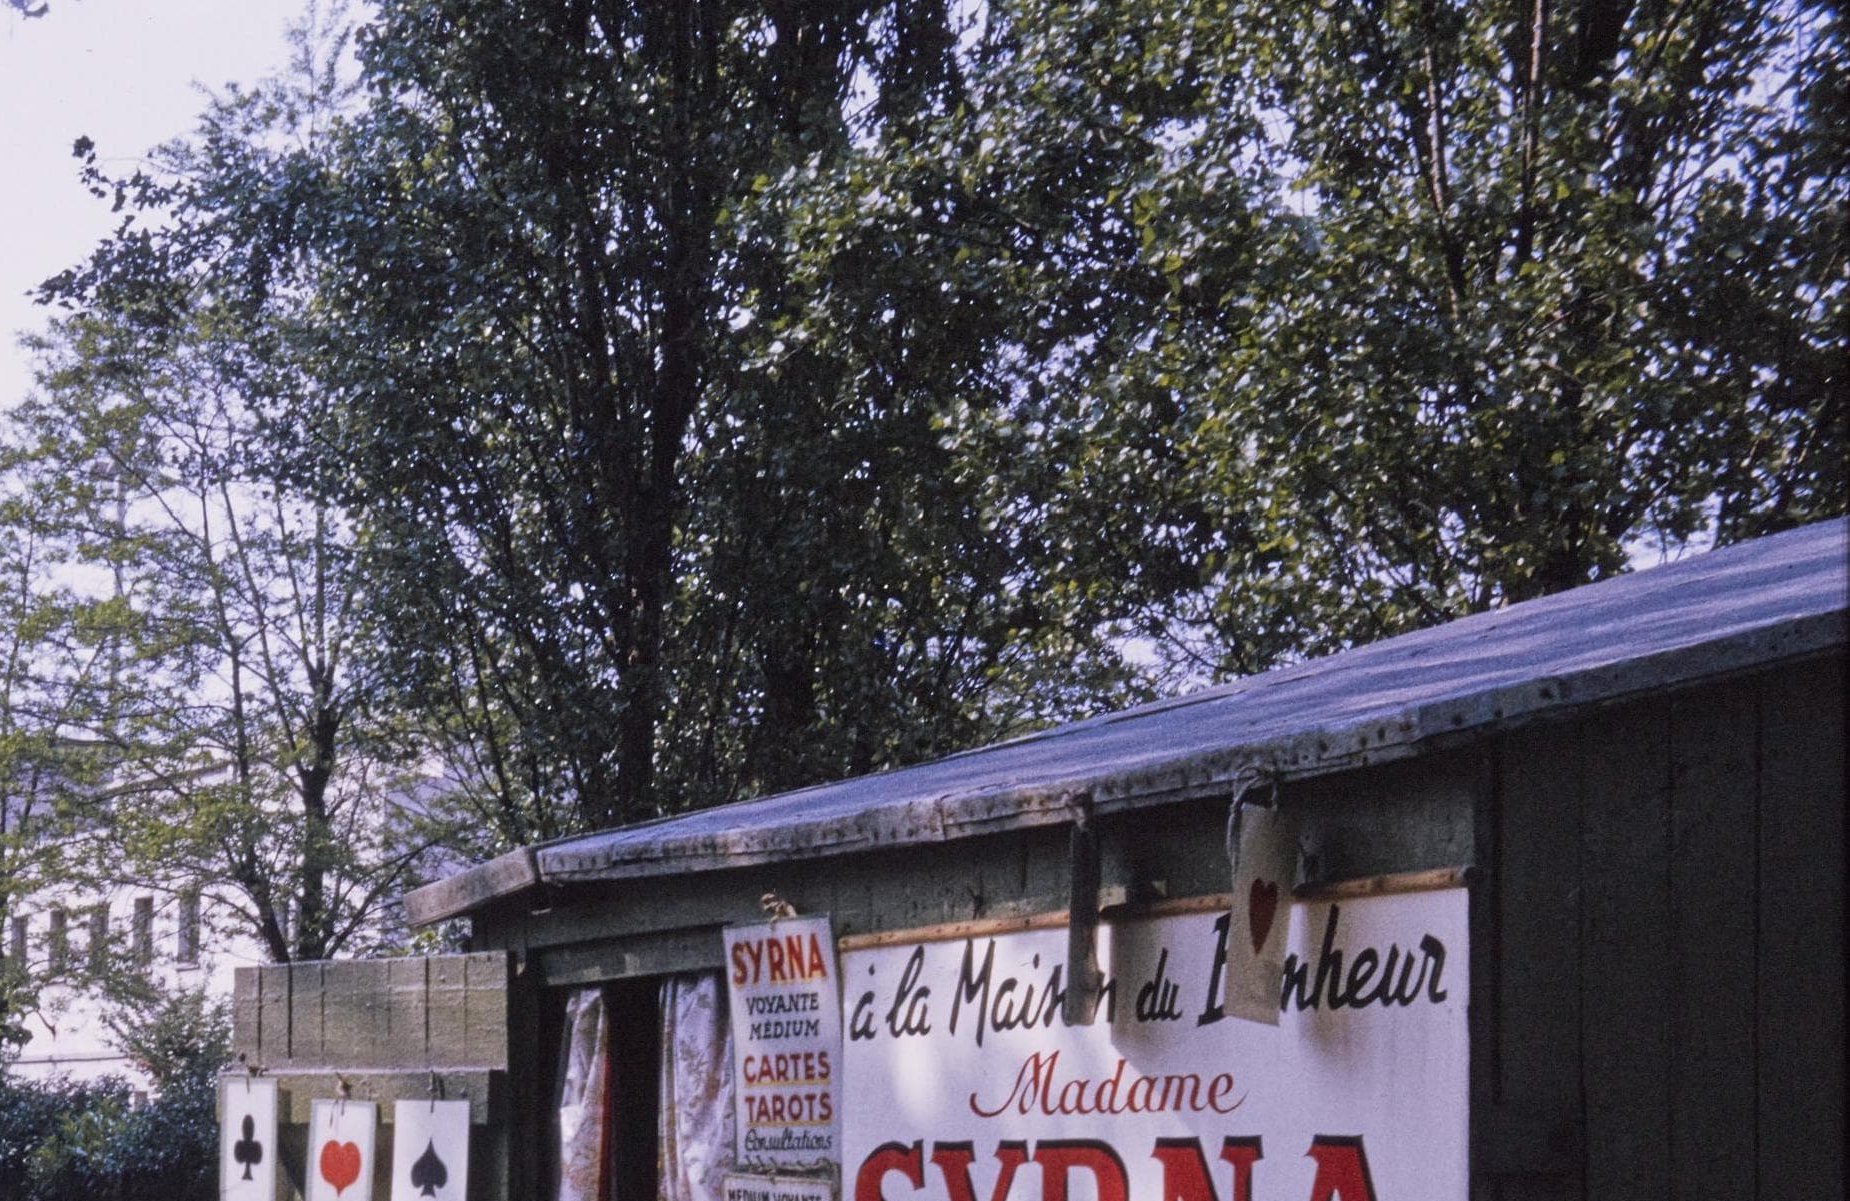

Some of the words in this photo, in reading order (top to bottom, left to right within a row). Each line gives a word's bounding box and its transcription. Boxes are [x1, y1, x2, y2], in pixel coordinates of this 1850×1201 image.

[731, 933, 827, 987] SYRNA
[886, 945, 931, 1037] la
[950, 936, 1117, 1047] Maisn
[1136, 948, 1182, 1022] du
[1197, 903, 1447, 1026] nheur
[746, 992, 820, 1016] VOYANTE
[743, 1051, 831, 1083] CARTES
[969, 1049, 1247, 1118] Madame
[744, 1092, 832, 1123] TAROTS
[745, 1126, 832, 1152] Consultations
